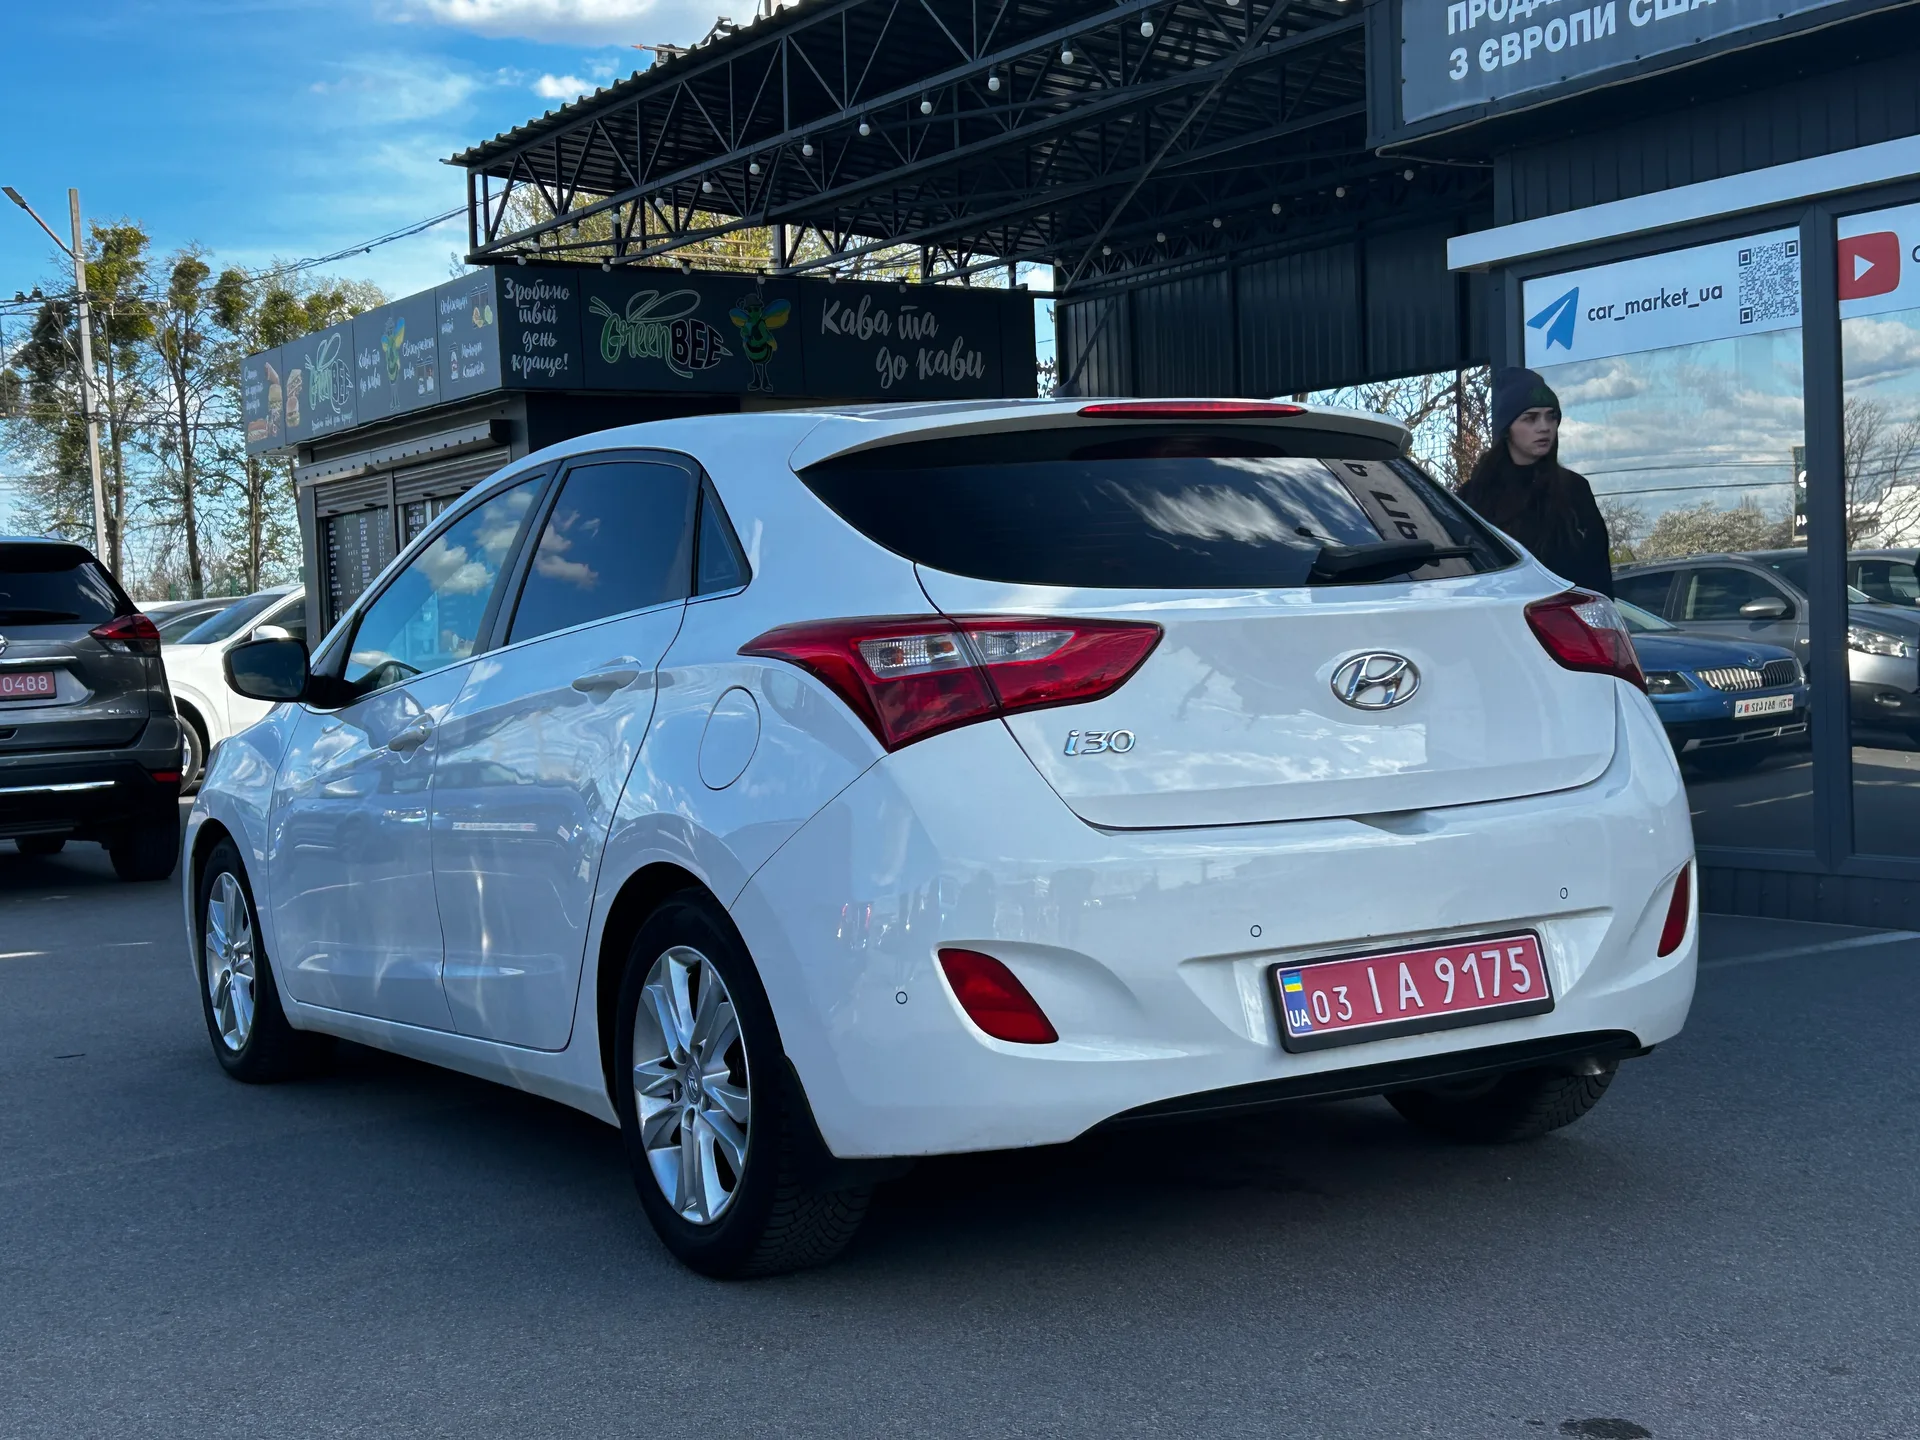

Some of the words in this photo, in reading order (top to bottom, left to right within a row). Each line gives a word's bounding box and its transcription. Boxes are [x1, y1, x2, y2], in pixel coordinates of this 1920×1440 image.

[1448, 0, 1561, 35] ПРОД
[1449, 48, 1468, 80] З
[1479, 8, 1616, 72] ЄВРОПИ
[1629, 0, 1717, 27] СШ
[504, 277, 570, 307] Зробимо
[1587, 284, 1723, 322] car_market_ua
[518, 301, 559, 325] твій
[821, 294, 893, 340] Кава
[898, 305, 940, 341] та
[522, 330, 558, 353] день
[511, 353, 569, 379] краще!
[875, 346, 909, 389] до
[916, 335, 986, 381] кави
[2, 676, 48, 692] 0488
[1064, 729, 1136, 756] i30
[1312, 986, 1353, 1024] 03
[1435, 946, 1532, 1004] 9175
[1290, 1009, 1312, 1028] UA
